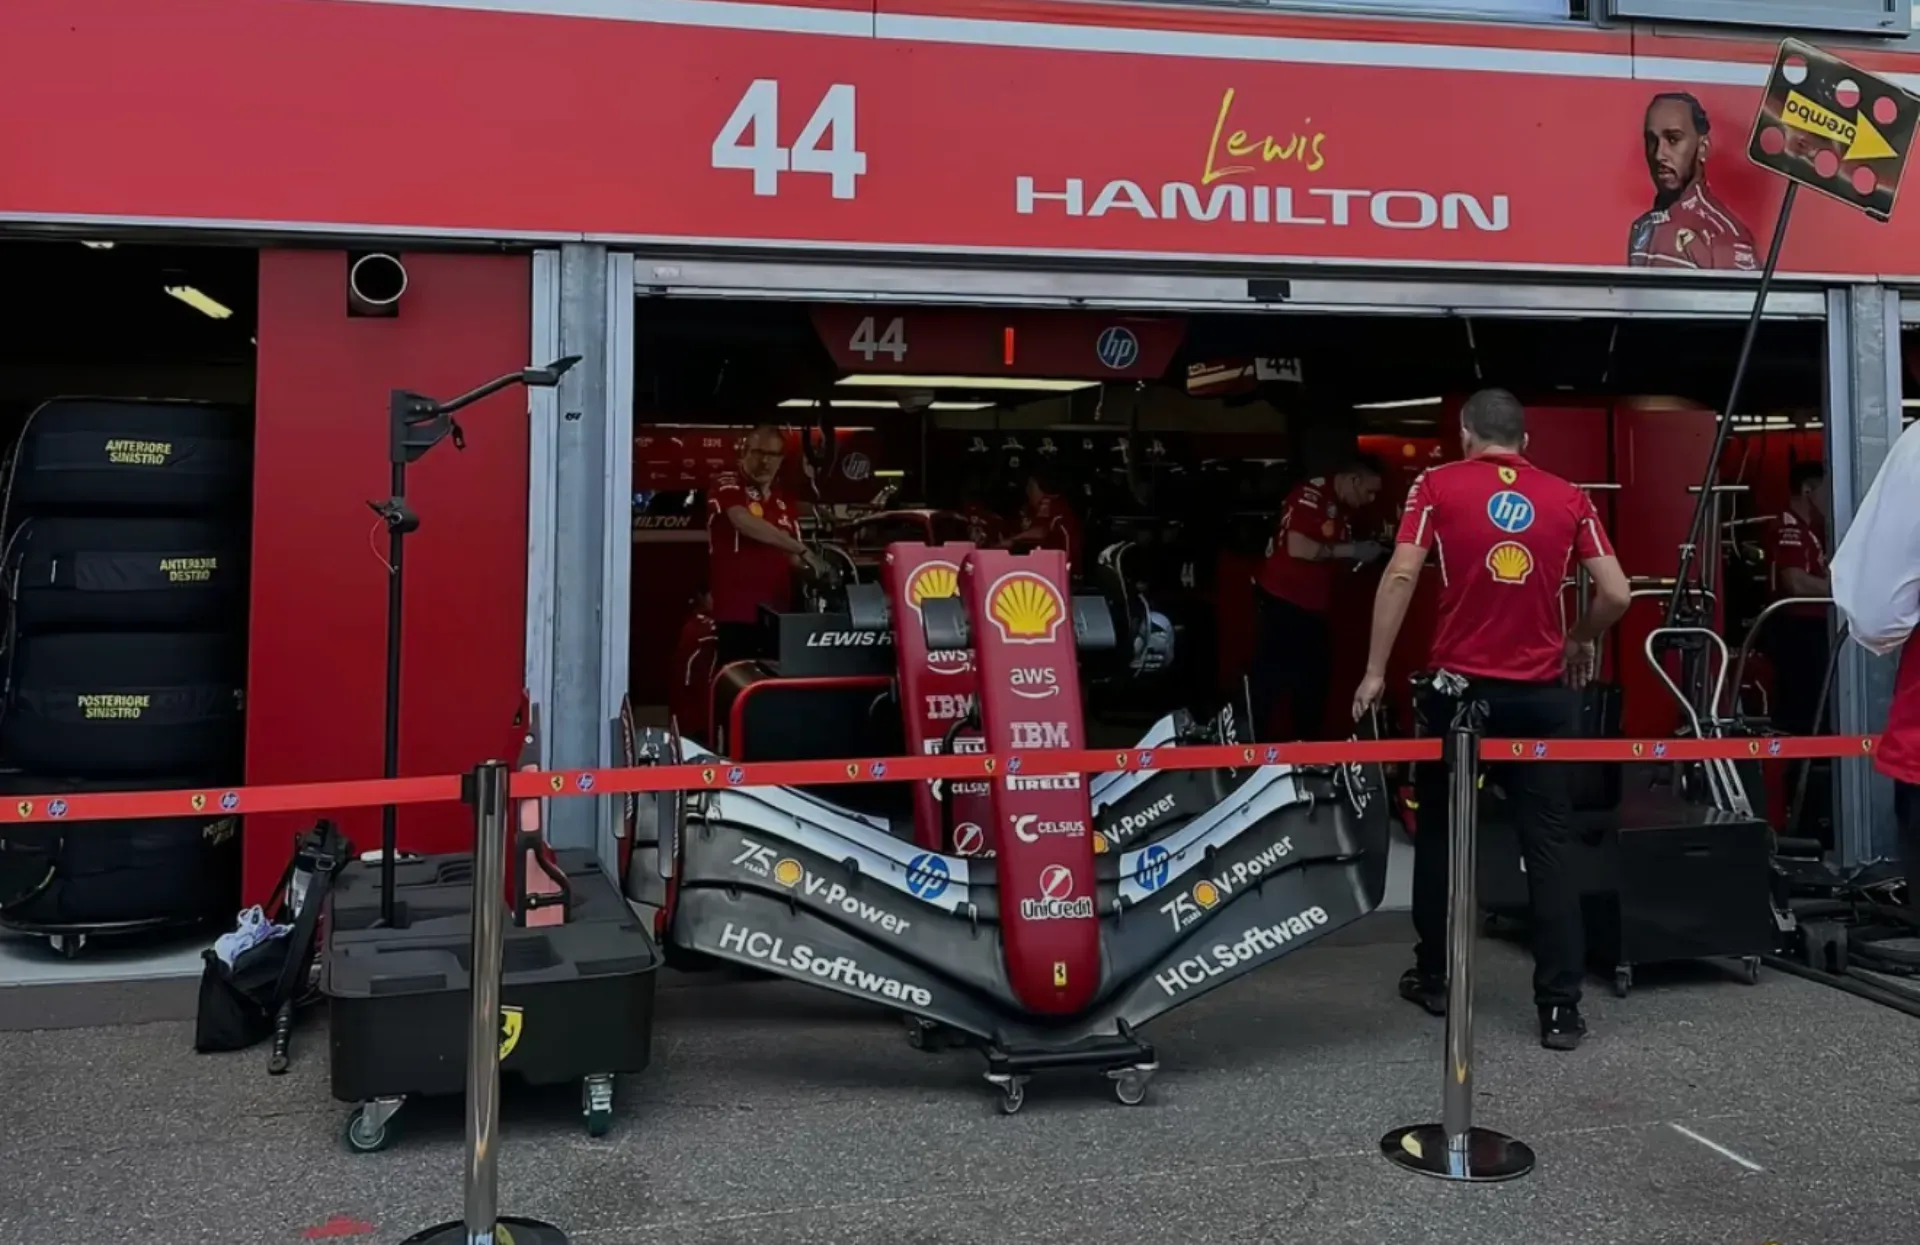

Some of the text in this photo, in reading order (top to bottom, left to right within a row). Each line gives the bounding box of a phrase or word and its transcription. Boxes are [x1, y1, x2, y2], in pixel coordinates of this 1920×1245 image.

[712, 79, 866, 199] 44
[1201, 88, 1325, 184] Lewis
[1786, 99, 1857, 144] brembo
[1016, 176, 1509, 231] HAMILTON
[849, 316, 907, 362] 44
[1100, 326, 1137, 369] hp
[105, 439, 172, 455] ANTERIORE
[109, 452, 165, 465] SINISTRO
[1491, 491, 1532, 533] hp
[806, 631, 876, 647] LEWIS
[1010, 667, 1057, 685] aws
[77, 694, 151, 708] POSTERIORE
[85, 707, 141, 720] SINISTRO
[1010, 721, 1071, 749] IBM
[1006, 772, 1080, 791] PIRELLI
[1037, 821, 1086, 835] CELSIUS
[1103, 793, 1176, 845] V-Power
[732, 838, 777, 871] 75
[1138, 845, 1168, 889] hp
[1212, 834, 1296, 895] V-Power
[908, 854, 949, 899] hp
[803, 871, 911, 935] V-Power
[1022, 898, 1093, 920] UniCredit
[1160, 891, 1197, 933] 75
[719, 923, 933, 1007] HCLSoftware
[1155, 905, 1329, 996] HCLSoftware
